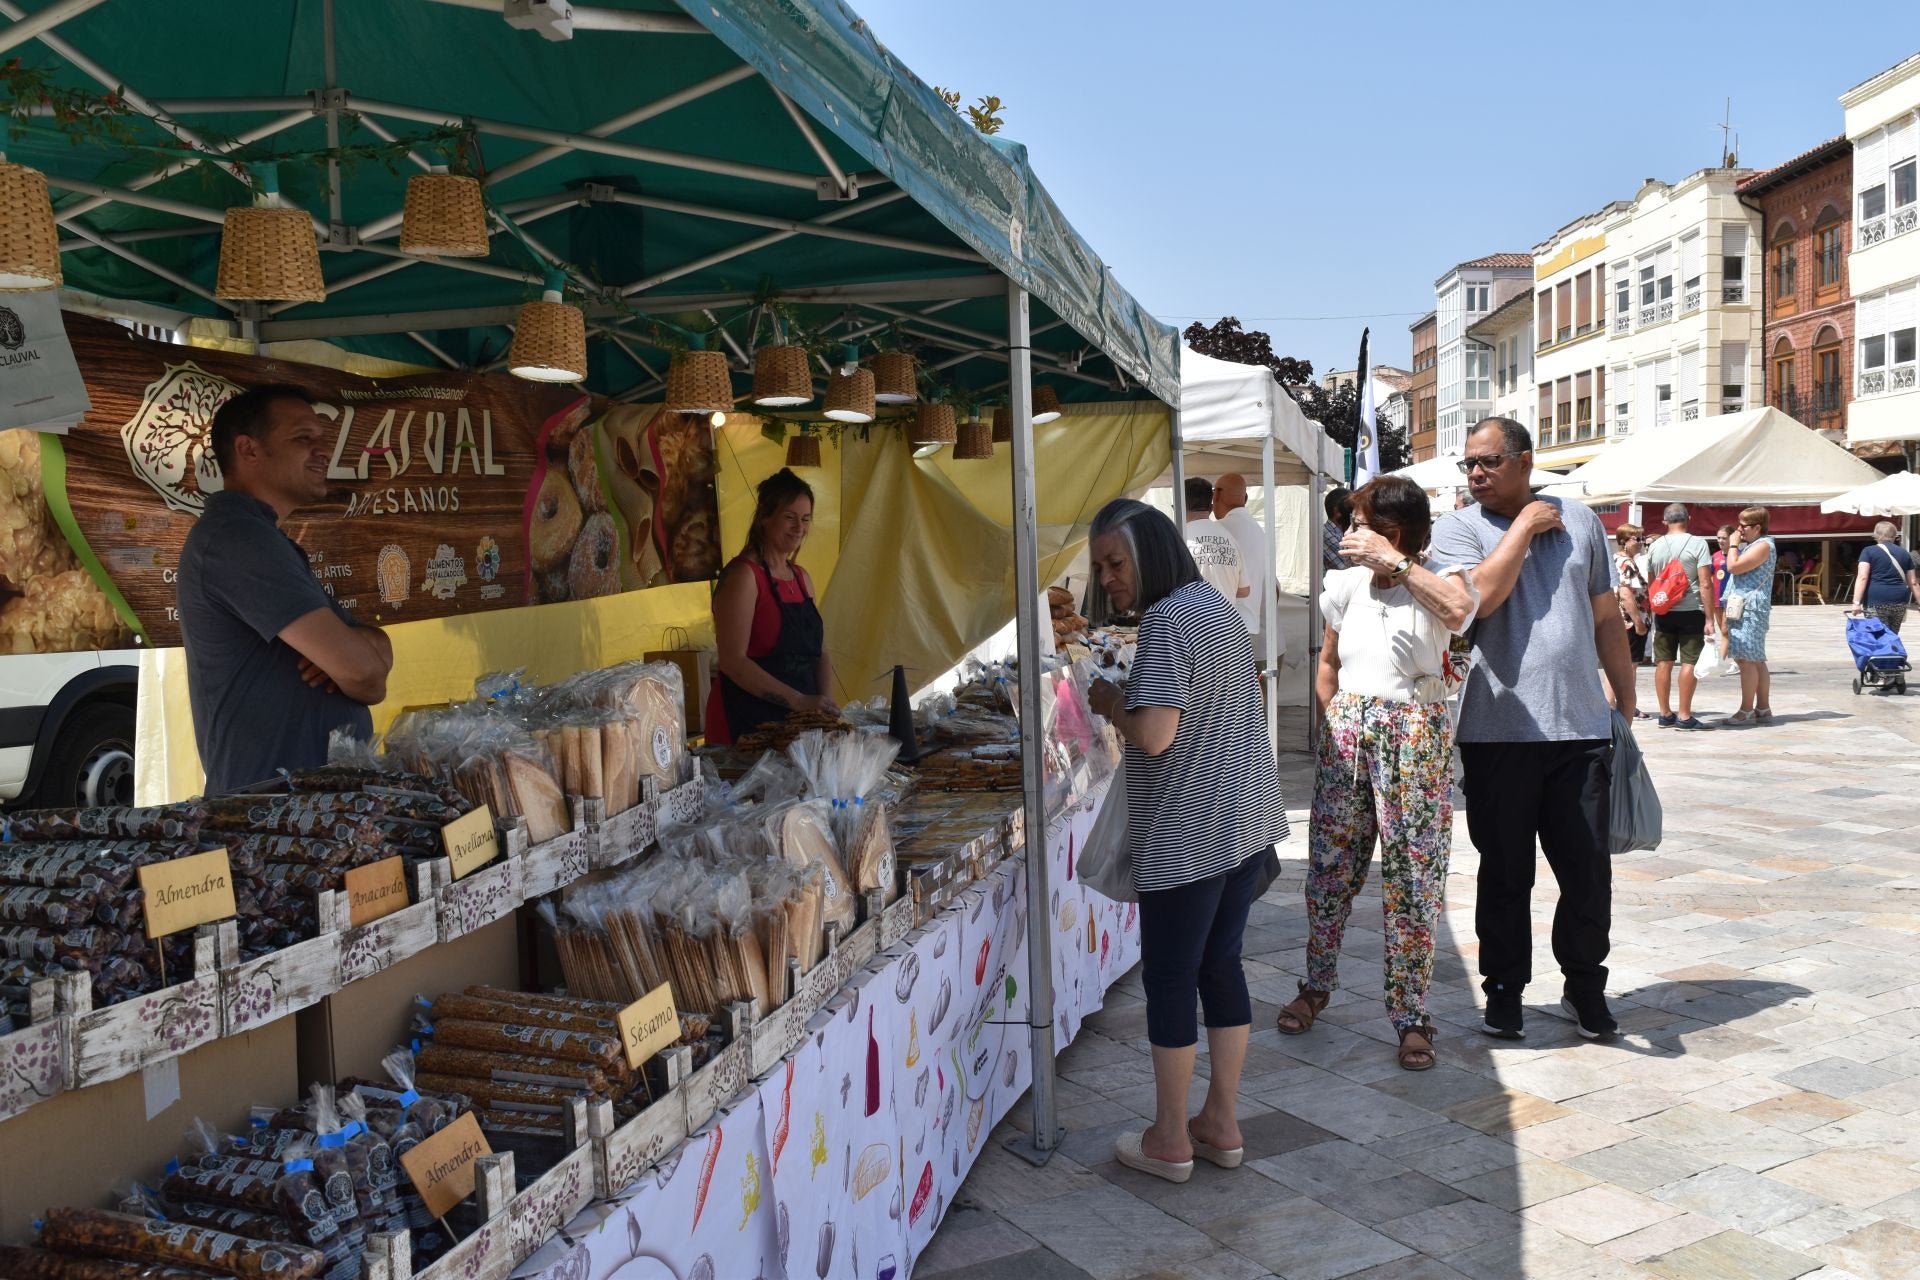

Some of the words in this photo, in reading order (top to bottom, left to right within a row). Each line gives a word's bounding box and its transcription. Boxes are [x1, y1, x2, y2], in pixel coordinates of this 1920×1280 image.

[324, 564, 353, 579] ARTIS
[427, 558, 464, 570] ALIMENTOS
[1207, 555, 1238, 567] QUIERO
[454, 828, 494, 862] Avellana
[154, 873, 226, 908] Almendra
[352, 876, 404, 909] Anacardo
[630, 1006, 673, 1048] Sésamo
[425, 1139, 483, 1189] Almendra
